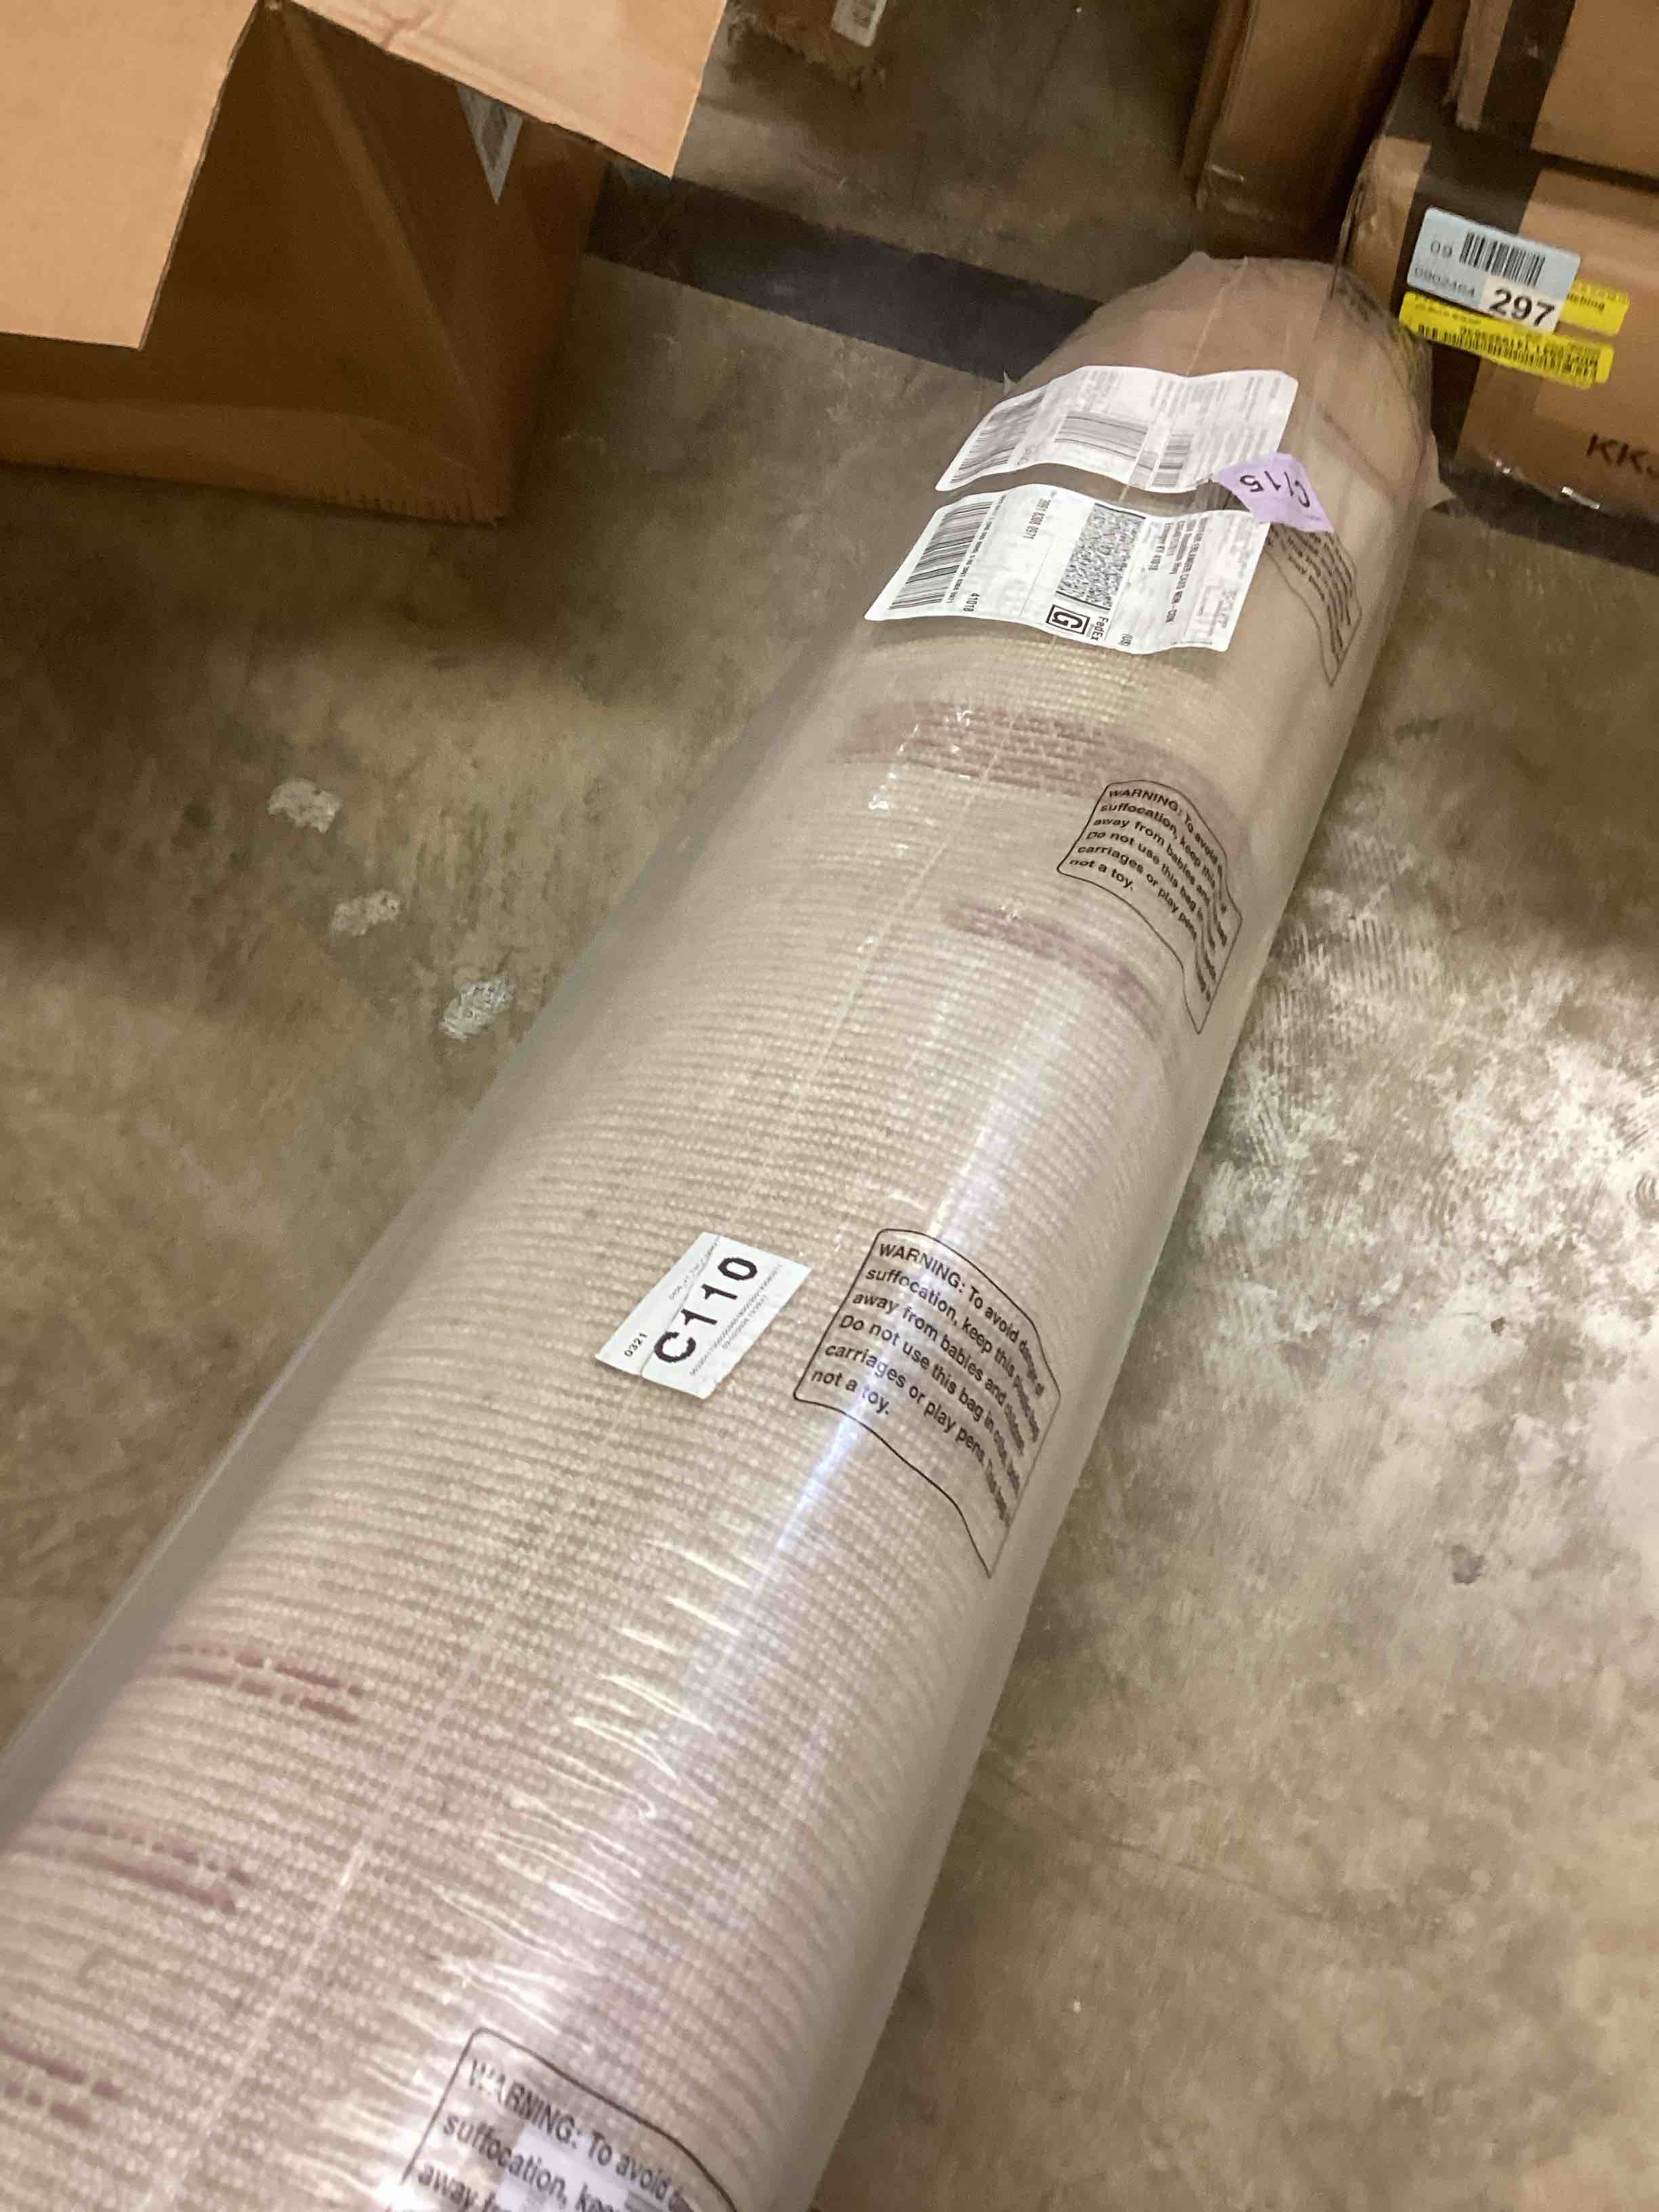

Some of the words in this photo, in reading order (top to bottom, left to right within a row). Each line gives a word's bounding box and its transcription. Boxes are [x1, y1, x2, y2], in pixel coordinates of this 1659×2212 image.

[1489, 287, 1555, 327] 297
[1051, 611, 1083, 629] G
[1090, 616, 1109, 642] FedEx
[1101, 802, 1178, 840] suffocation,
[1109, 788, 1183, 816] WARNING:
[1086, 832, 1106, 840] Do
[1110, 832, 1135, 845] not
[1138, 843, 1160, 865] use
[1161, 863, 1179, 888] this
[1093, 819, 1130, 828] away
[1134, 821, 1165, 846] from
[1069, 859, 1096, 867] not
[1098, 864, 1107, 873] a
[1078, 846, 1144, 874] carriages
[1146, 873, 1158, 886] or
[1158, 888, 1179, 914] play
[654, 1256, 758, 1364] C110
[879, 1243, 966, 1294] WARNING:
[969, 1284, 983, 1310] To
[985, 1306, 1020, 1343] avoid
[623, 1331, 648, 1358] 0321
[852, 1293, 899, 1315] away
[902, 1305, 939, 1341] from
[940, 1333, 983, 1382] babies
[985, 1378, 1007, 1406] and
[865, 1268, 958, 1327] suffocation,
[961, 1316, 993, 1355] keep
[994, 1347, 1015, 1378] this
[811, 1369, 844, 1387] not
[845, 1378, 858, 1393] a
[861, 1383, 890, 1415] toy.
[824, 1344, 907, 1389] carriages
[908, 1385, 926, 1405] or
[923, 1400, 957, 1433] play
[839, 1314, 865, 1331] Do
[868, 1323, 901, 1346] not
[902, 1340, 930, 1370] use
[931, 1364, 957, 1395] this
[958, 1387, 984, 1422] bag
[443, 2113, 568, 2210] suffocation,
[575, 2182, 614, 2212] ke
[588, 2128, 613, 2167] To
[615, 2154, 673, 2202] avoid
